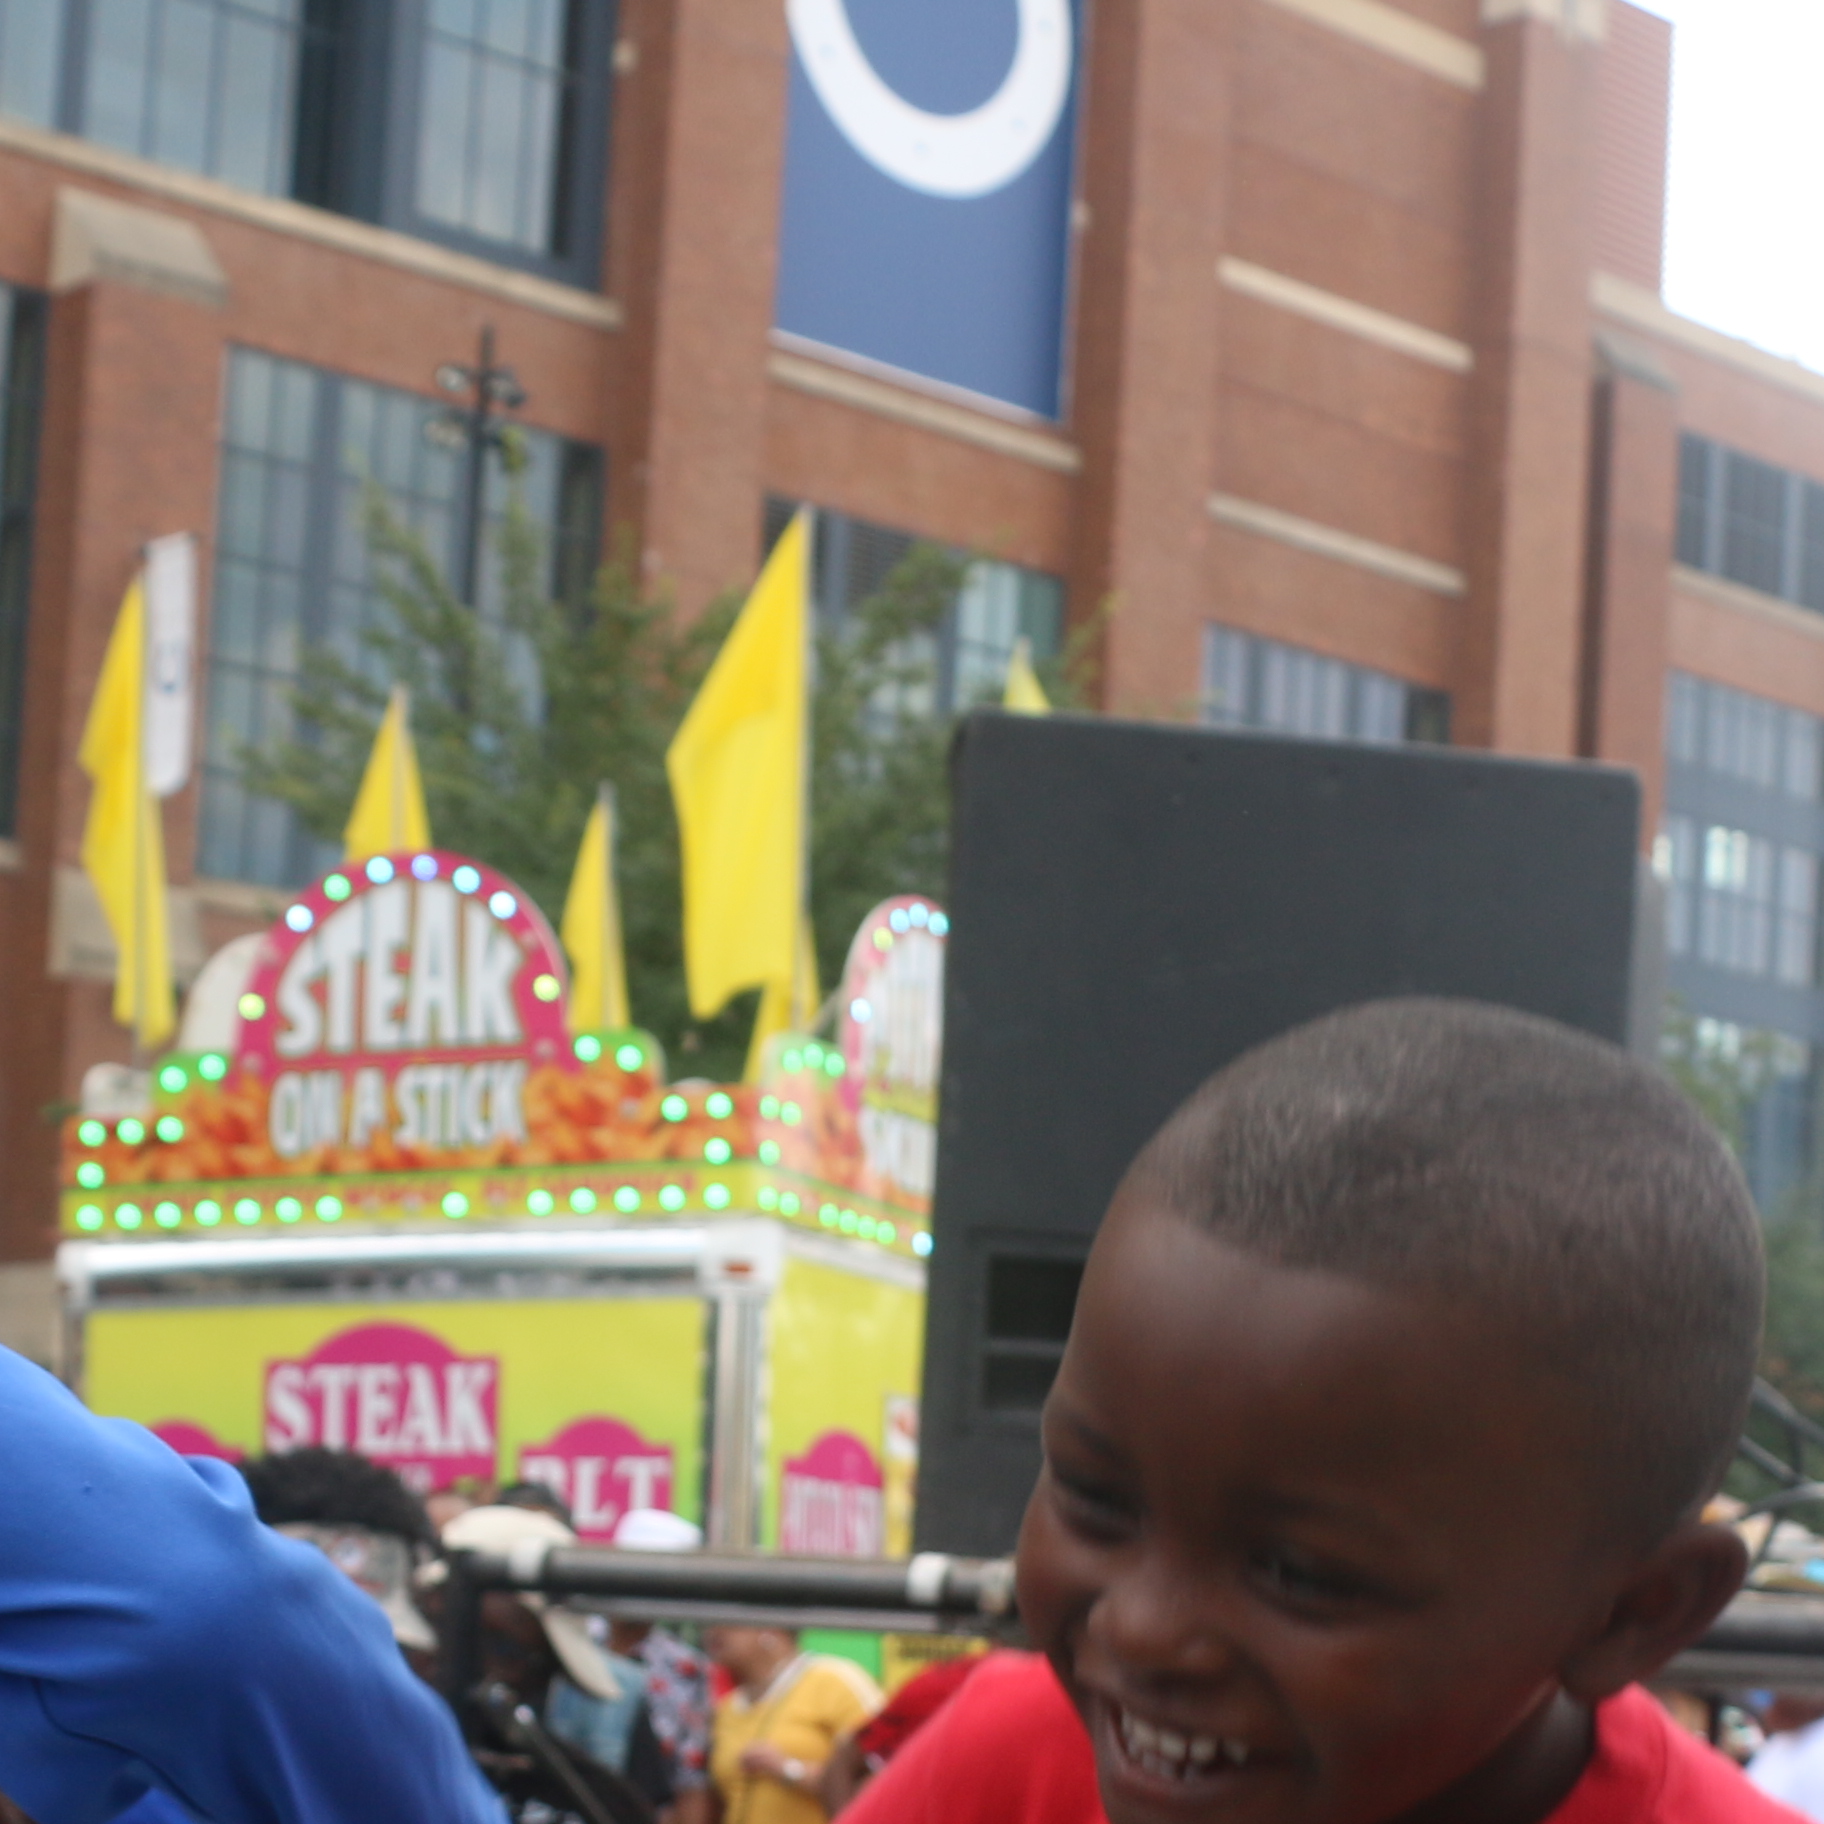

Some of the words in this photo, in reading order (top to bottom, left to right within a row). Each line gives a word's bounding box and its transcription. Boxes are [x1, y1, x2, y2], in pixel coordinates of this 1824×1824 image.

[276, 876, 524, 1058] STEAK
[269, 1066, 344, 1156] ON
[348, 1062, 387, 1148] A
[390, 1056, 529, 1150] STICK
[266, 1361, 493, 1457] STEAK
